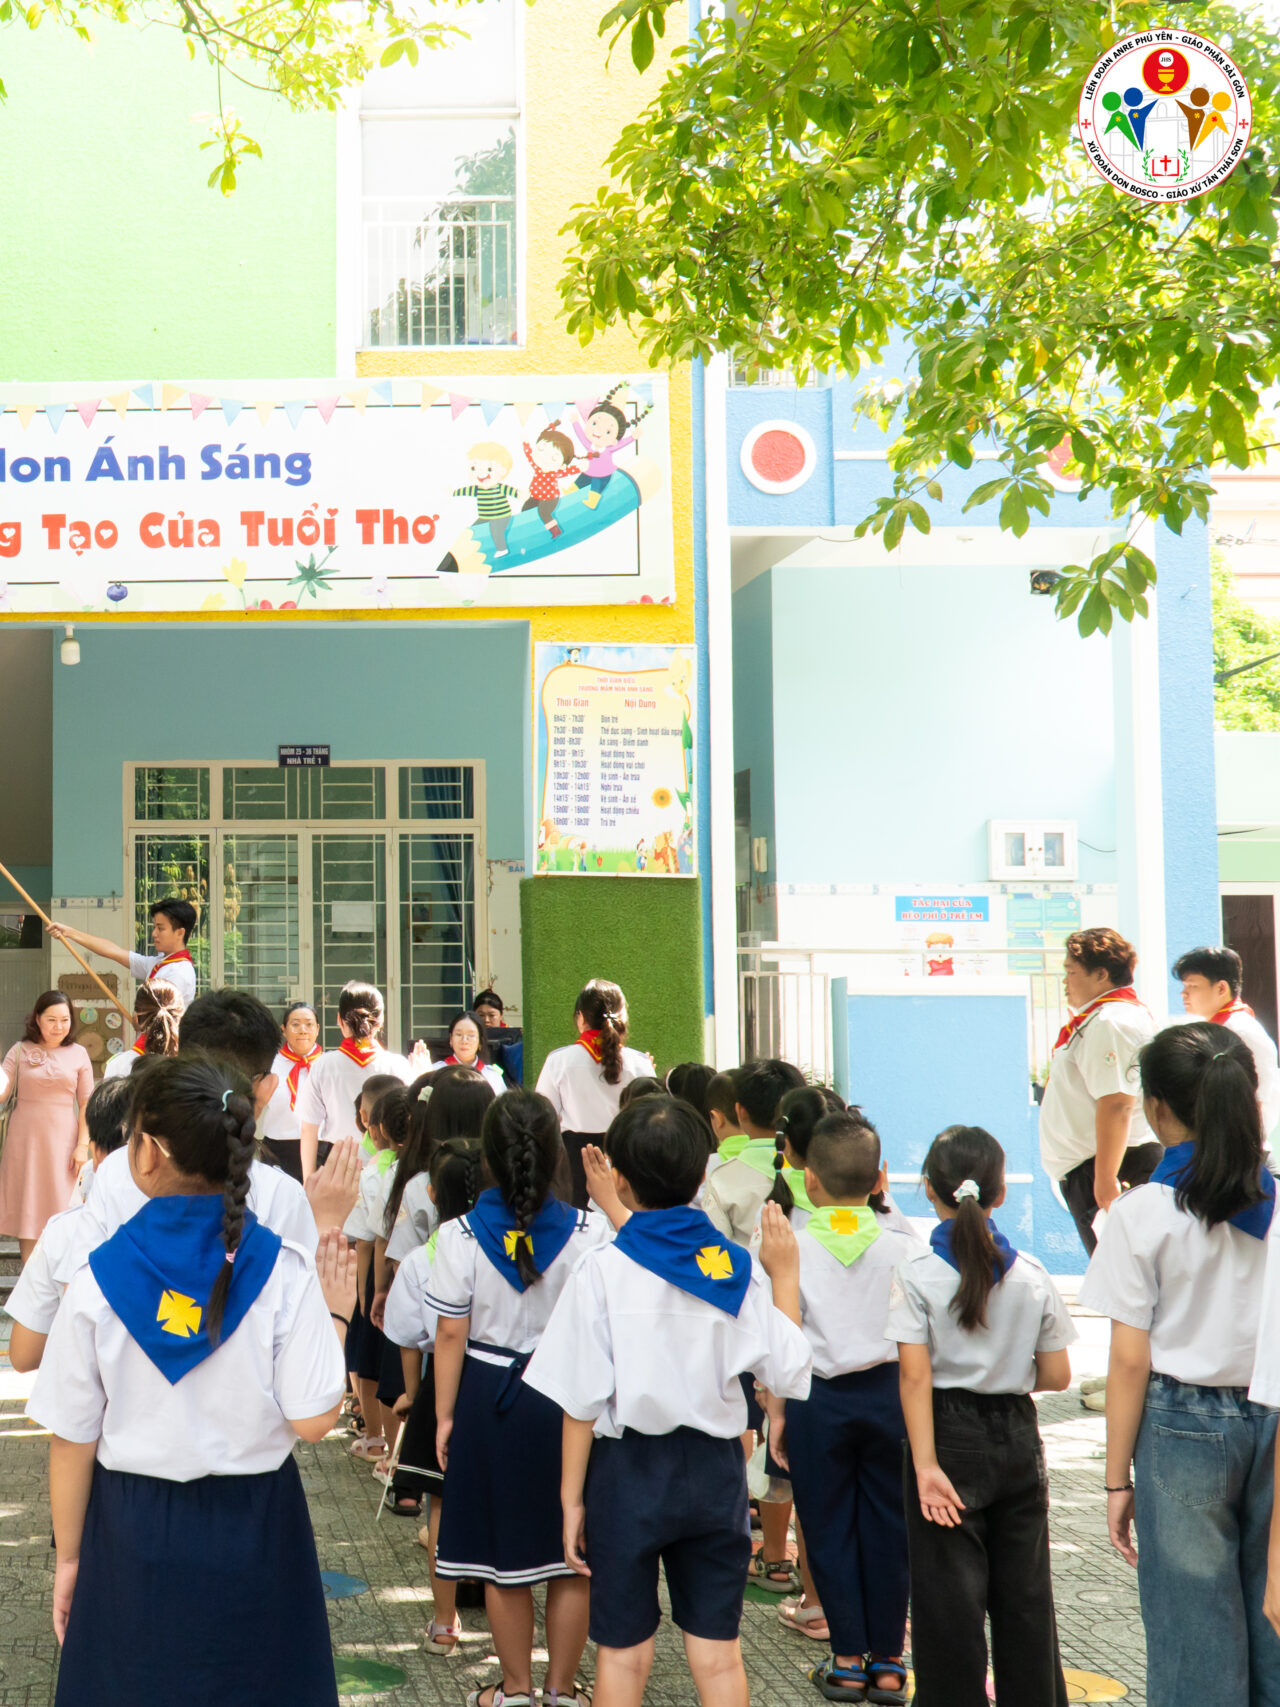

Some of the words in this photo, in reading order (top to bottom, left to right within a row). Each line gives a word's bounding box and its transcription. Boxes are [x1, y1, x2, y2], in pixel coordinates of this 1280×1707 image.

[85, 436, 186, 482] Ánh
[200, 443, 312, 487] Sáng
[42, 513, 119, 557] Tạo
[139, 511, 221, 549] Của
[240, 502, 339, 547] Tuổi
[355, 508, 440, 546] Thơ
[573, 697, 589, 707] Gian
[638, 698, 656, 709] Dung
[969, 912, 983, 920] EM
